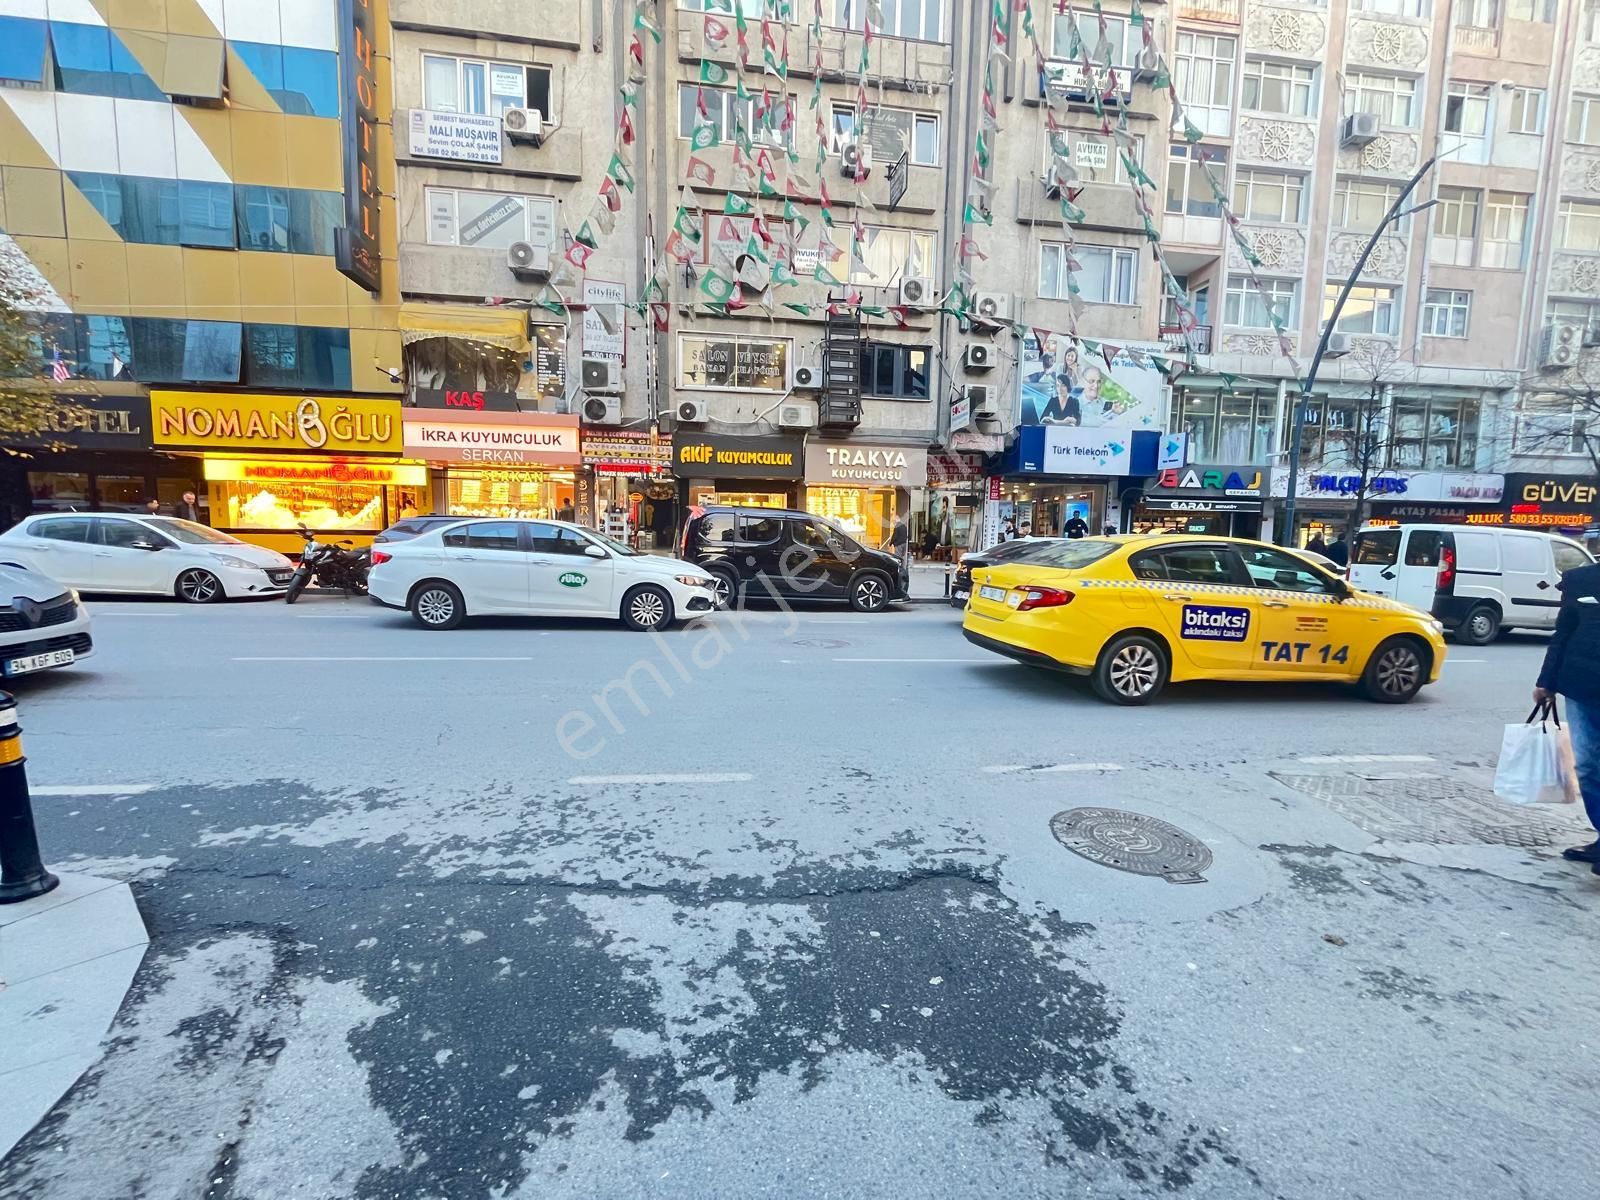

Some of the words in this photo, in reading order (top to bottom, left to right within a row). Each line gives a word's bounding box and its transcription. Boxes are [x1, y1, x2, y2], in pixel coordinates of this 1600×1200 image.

[355, 26, 375, 240] HOTEL
[429, 125, 453, 137] MALİ
[450, 140, 475, 149] ÇOLAK
[1077, 143, 1107, 156] AVUKAT
[588, 287, 621, 298] citylife
[692, 350, 728, 362] SALON
[446, 390, 485, 411] KAŞ
[422, 428, 457, 443] İKRA
[461, 431, 562, 447] KUYUMCULUK
[638, 438, 672, 446] GİİM
[462, 449, 524, 463] SERKAN
[681, 442, 713, 464] AKİF
[717, 451, 793, 466] KUYUMCULUK
[1053, 445, 1071, 455] Türk
[1073, 446, 1109, 457] Telekom
[826, 448, 908, 468] TRAKYA
[831, 469, 902, 481] KUYUMCUSU
[1159, 469, 1262, 490] GARAJ
[1170, 502, 1212, 510] GARAJ
[1391, 506, 1426, 519] AKTAŞ
[1185, 609, 1248, 629] bitaksi
[1222, 629, 1244, 638] taksi
[1261, 641, 1312, 663] TAT
[1319, 644, 1350, 665] 14
[12, 660, 26, 672] 34
